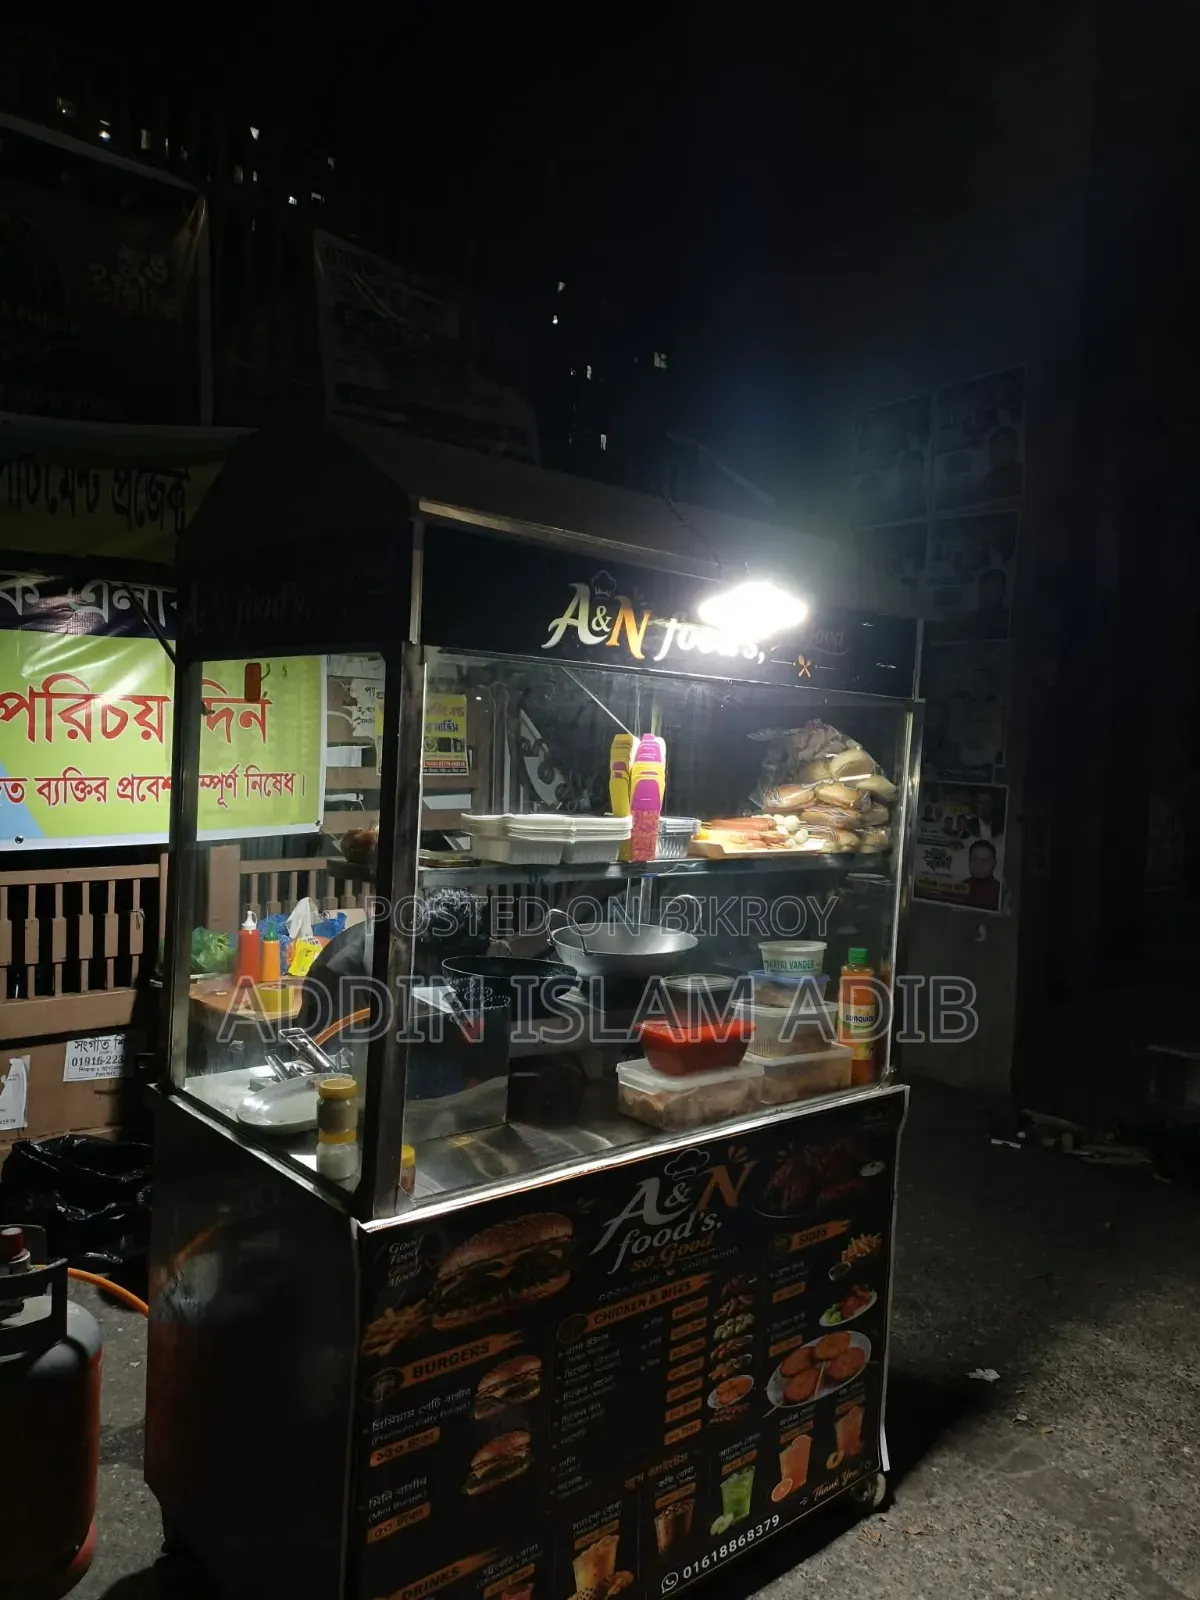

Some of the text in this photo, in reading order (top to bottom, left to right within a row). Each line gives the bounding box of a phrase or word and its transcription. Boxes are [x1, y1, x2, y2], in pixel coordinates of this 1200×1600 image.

[67, 578, 178, 628] এলা
[540, 581, 652, 661] A&N
[34, 766, 111, 807] ব্যক্তির
[199, 763, 240, 809] ম্পূর্ণ
[589, 1159, 761, 1257] A&N
[412, 1340, 491, 1379] BURGERS
[682, 1513, 781, 1579] 01618868379
